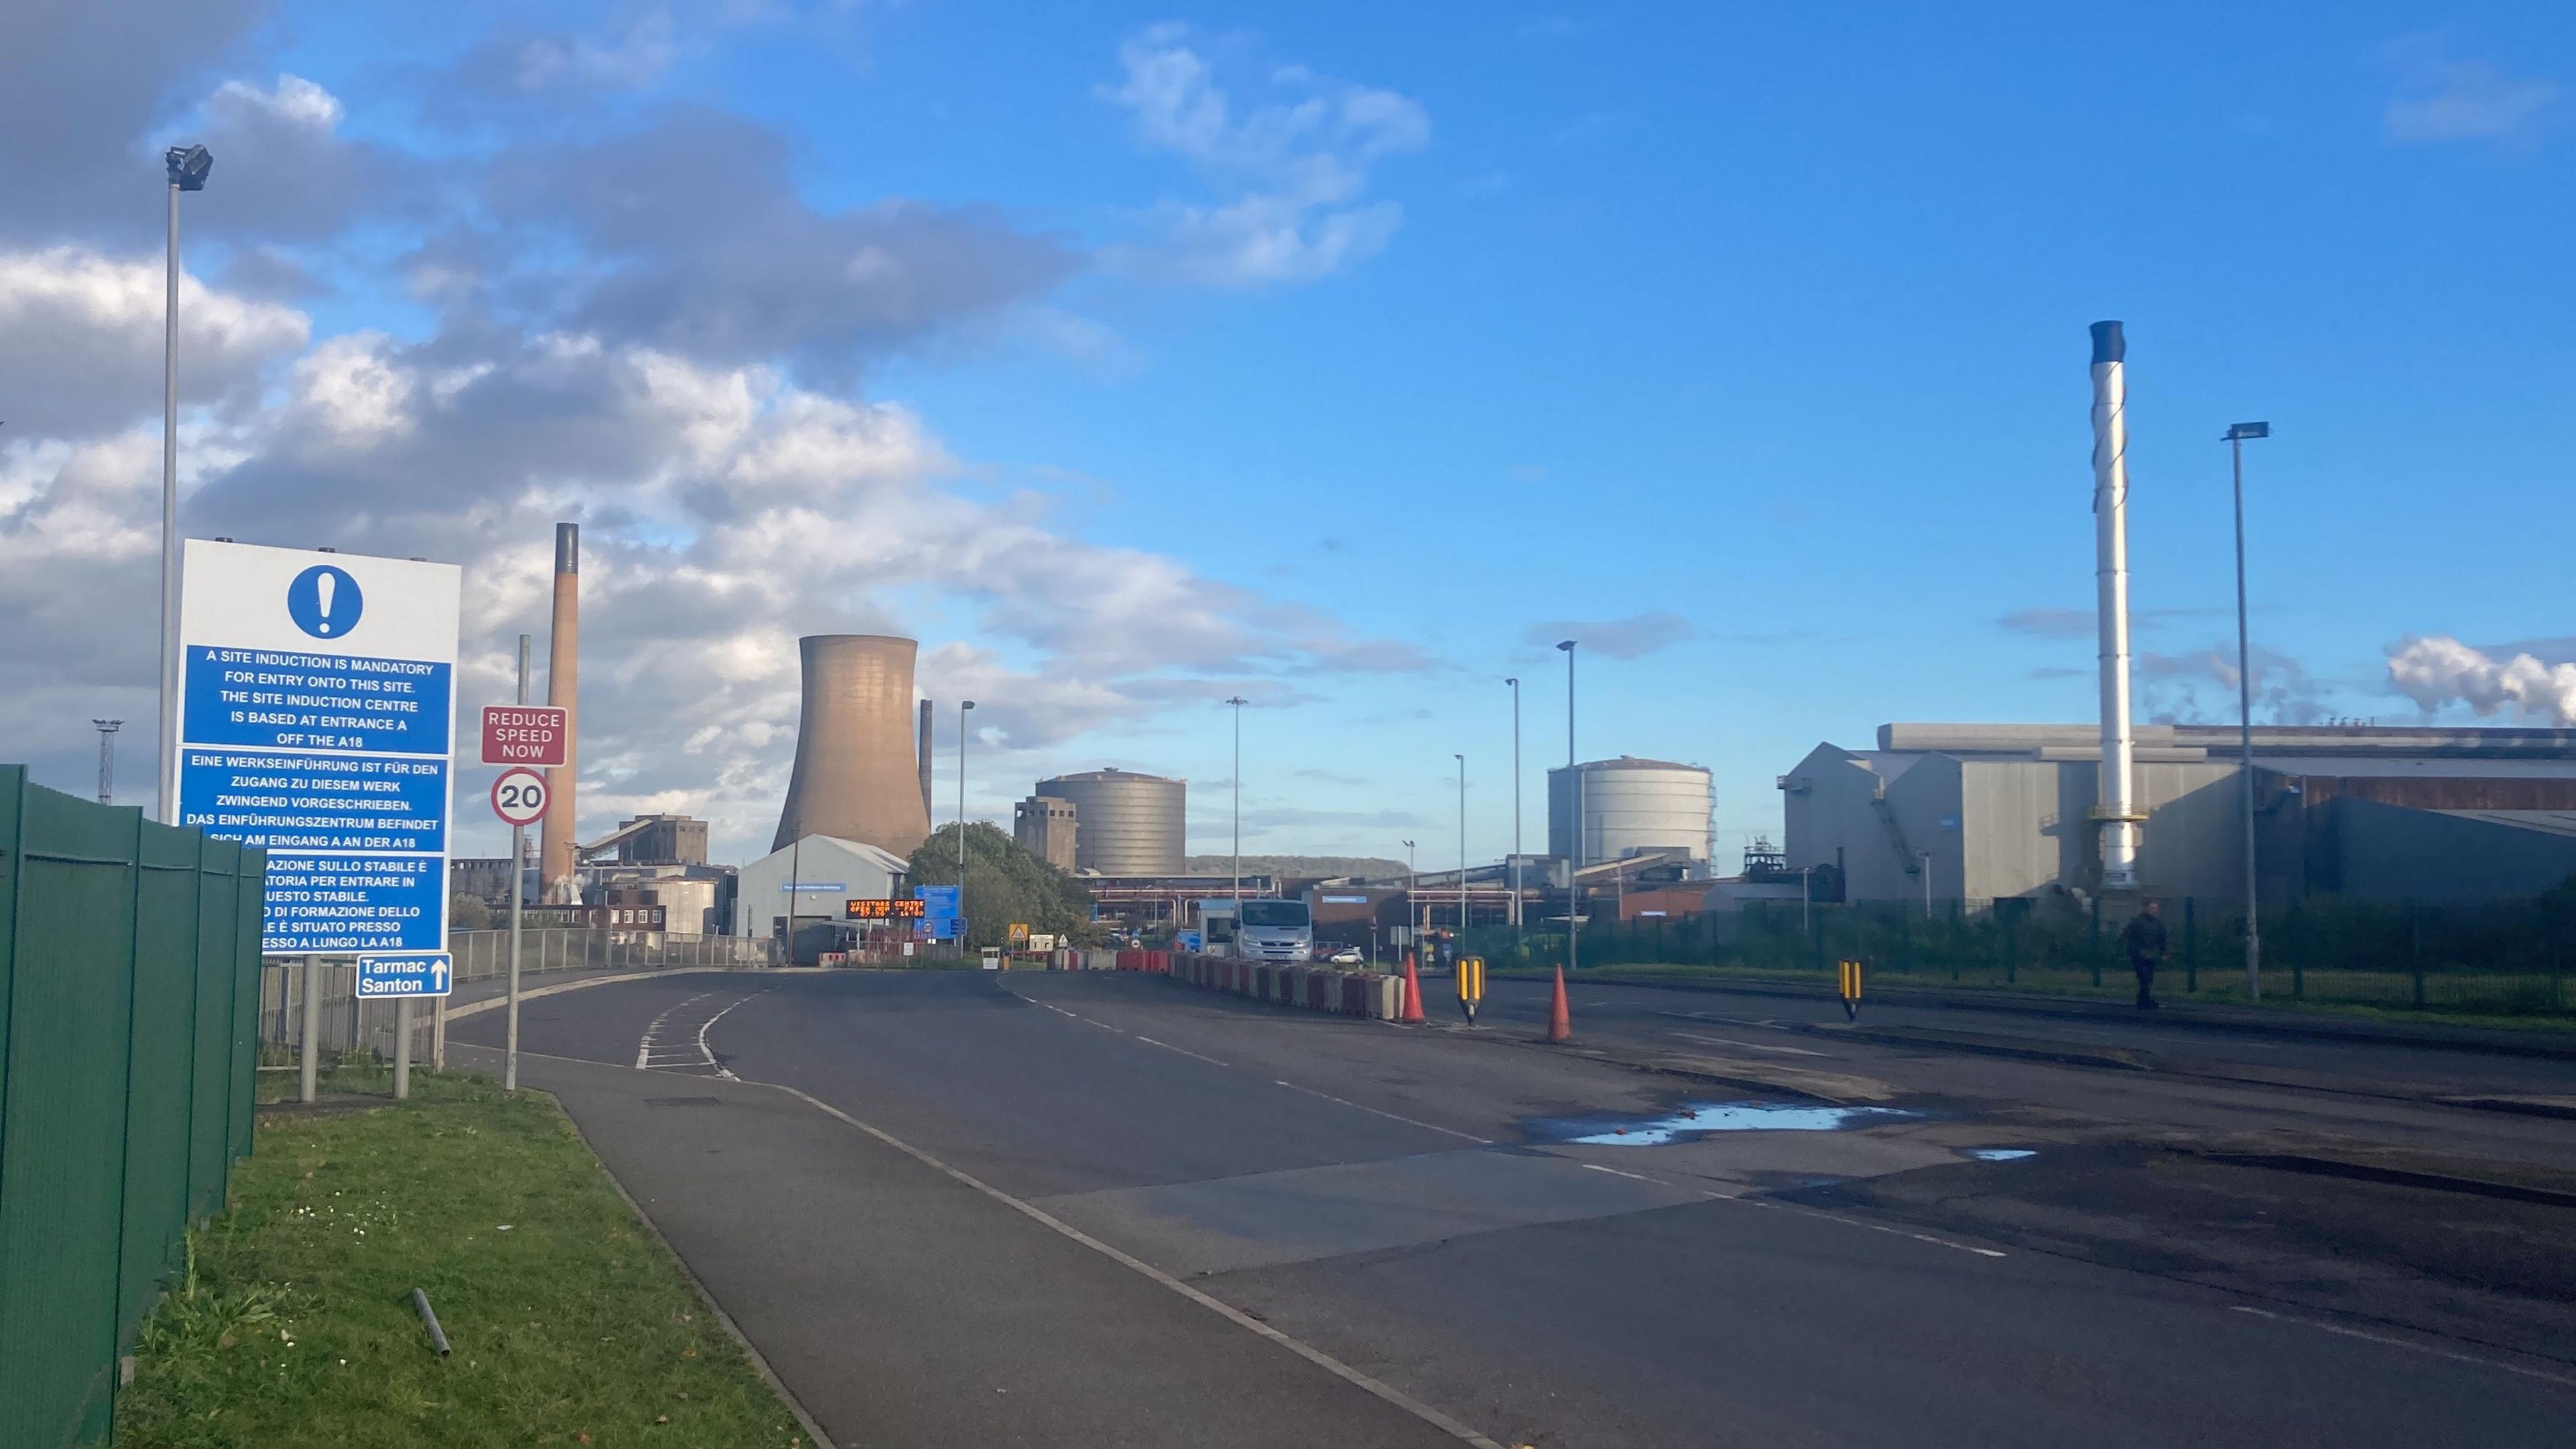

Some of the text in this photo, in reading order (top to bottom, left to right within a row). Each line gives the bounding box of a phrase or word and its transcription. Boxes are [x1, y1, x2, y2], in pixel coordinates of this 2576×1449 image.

[206, 650, 433, 675] A SITE INDUCTION IS MANDATORY
[225, 671, 415, 692] FOR ENTRY ONTO THIS SITE.
[221, 690, 418, 712] THE SITE INDUCTION CENTRE
[231, 711, 407, 730] IS BASED AT ENTRANCE A
[489, 712, 560, 727] REDUCE
[277, 733, 362, 747] OFF THE A18
[496, 729, 553, 742] SPEED
[503, 745, 545, 757] NOW
[192, 755, 437, 774] EINE WERKSEINFÜHRUNG IST FÜR DEN
[231, 776, 400, 792] ZUGANG ZU DIESEM WERK
[217, 795, 411, 810] ZWINGEND VORGESCHRIEBEN.
[501, 785, 542, 808] 20
[187, 814, 438, 830] DAS EINFÜHRUNGSZENTRUM BEFINDET
[245, 835, 265, 845] AM
[270, 835, 328, 846] EINGANG
[331, 837, 340, 846] A
[343, 837, 360, 847] AN
[365, 837, 390, 847] DER
[392, 838, 415, 848] A18
[266, 859, 427, 872] AZIONE SULLO STABILE È
[311, 876, 336, 886] PER
[340, 876, 399, 886] ENTRARE
[402, 877, 415, 887] IN
[266, 892, 368, 902] UESTO STABILE.
[275, 907, 287, 917] DI
[291, 907, 375, 917] FORMAZIONE
[379, 907, 420, 917] DELLO
[280, 920, 288, 932] È
[292, 922, 345, 932] SITUATO
[350, 922, 400, 932] PRESSO
[300, 938, 309, 948] A
[313, 937, 358, 947] LUNGO
[362, 937, 378, 947] LA
[380, 937, 402, 947] A18
[362, 959, 427, 974] Tarmac
[362, 978, 423, 993] Santon
